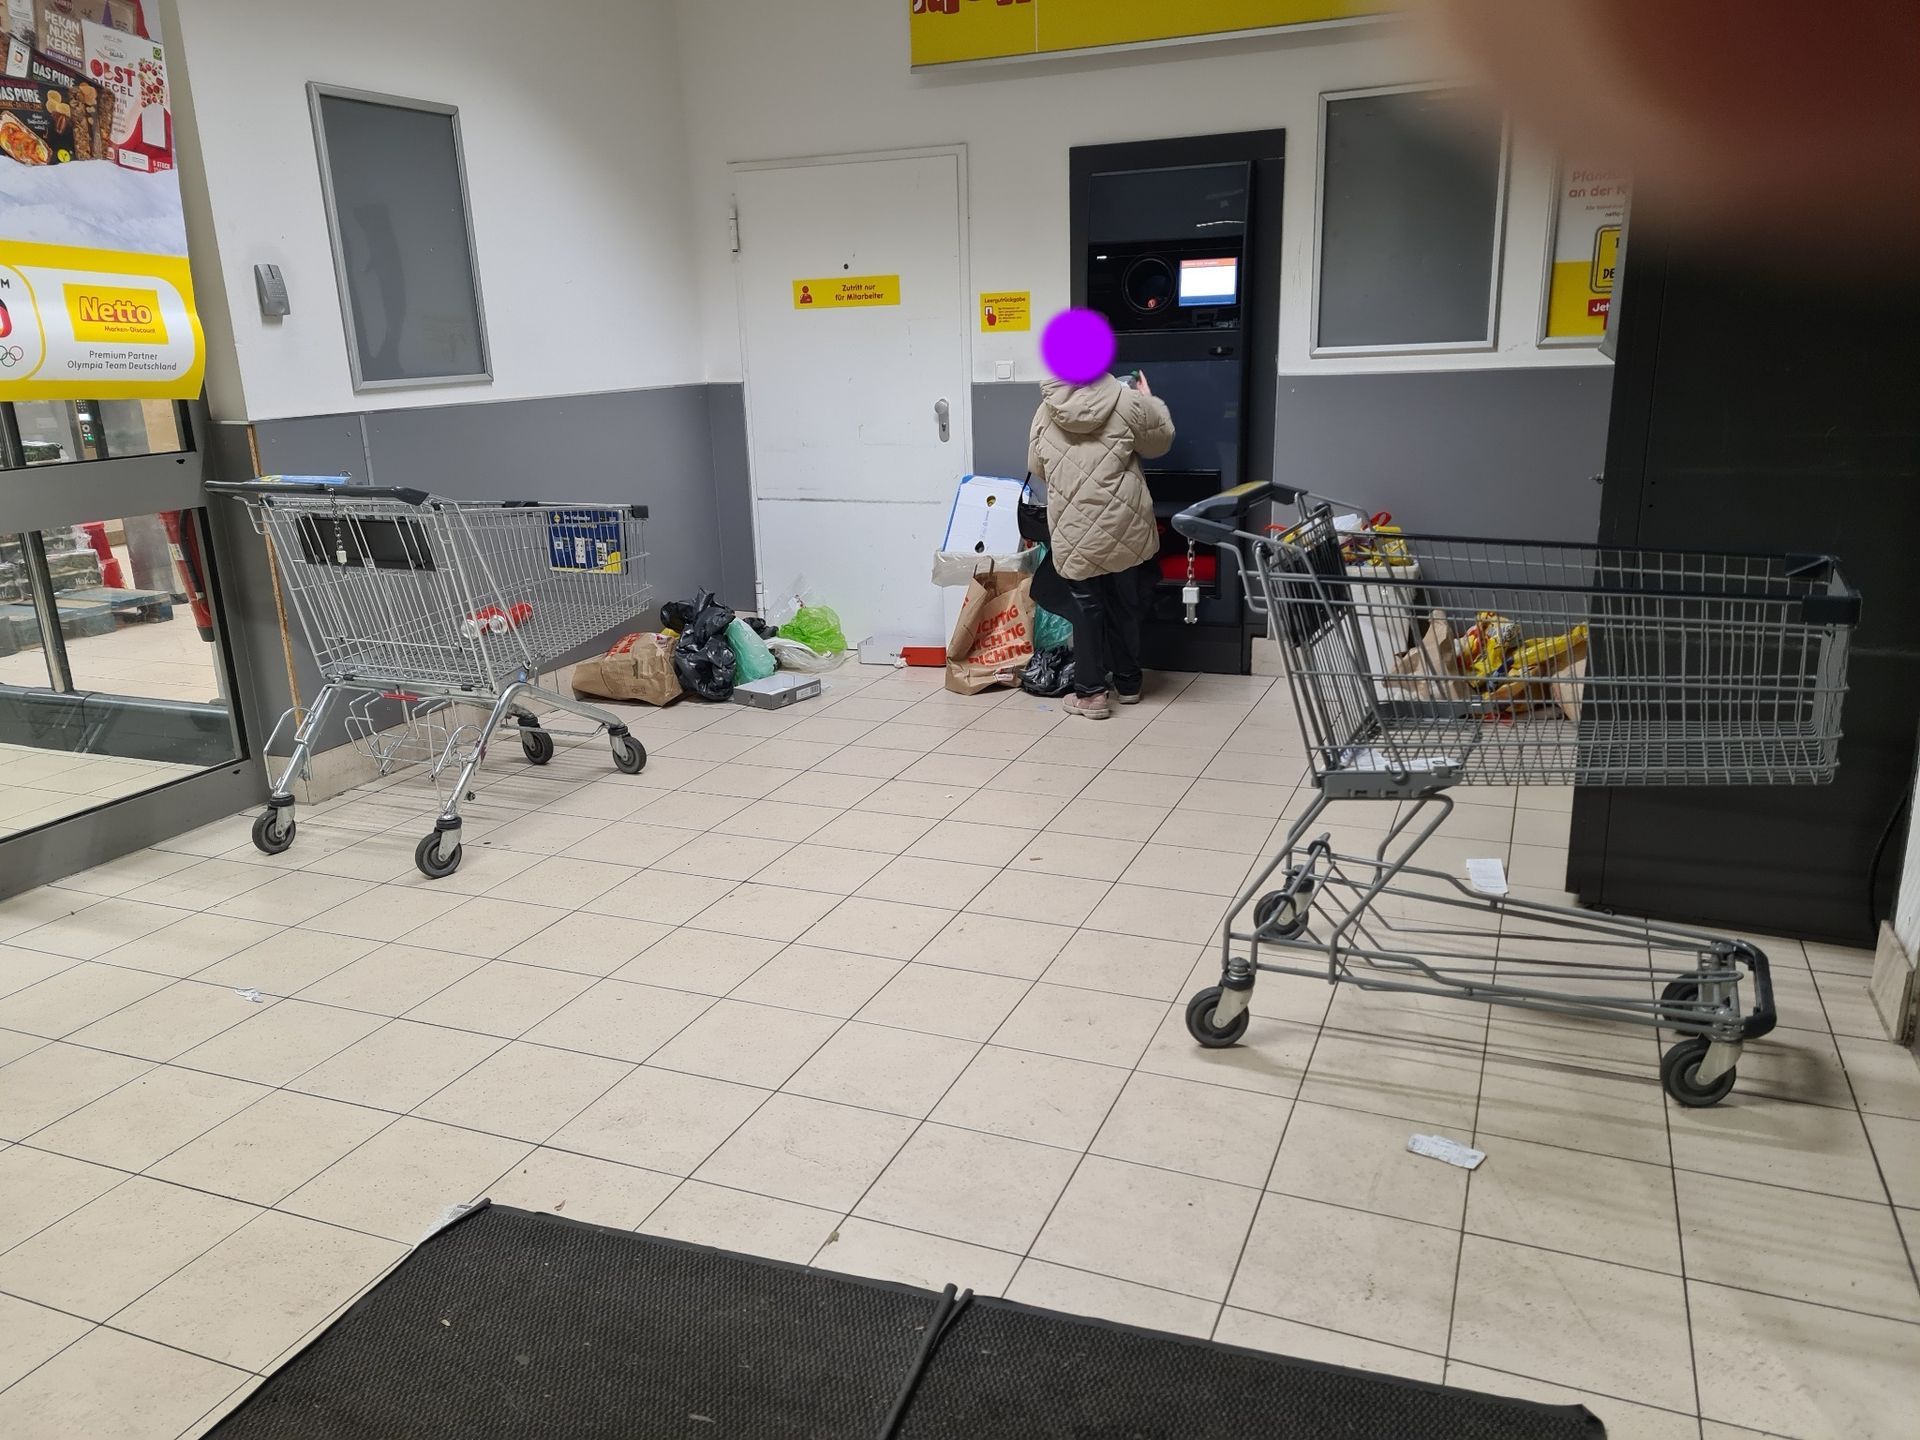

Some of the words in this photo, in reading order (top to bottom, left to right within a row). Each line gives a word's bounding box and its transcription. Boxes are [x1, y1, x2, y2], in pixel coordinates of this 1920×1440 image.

[44, 9, 80, 35] PEKAN
[49, 23, 77, 44] NUSS
[47, 35, 83, 59] KERNE
[33, 62, 51, 80] DAS
[52, 69, 76, 88] PURE
[90, 58, 136, 87] OBST
[0, 87, 14, 101] AS
[14, 88, 41, 103] PURE
[1568, 188, 1586, 198] an
[1602, 267, 1615, 280] DE
[0, 278, 10, 289] M
[842, 284, 863, 292] Zutritt
[835, 293, 845, 301] für
[846, 292, 884, 301] Mitarbeiter
[79, 295, 152, 325] Netto
[1592, 302, 1611, 313] Jet
[105, 325, 156, 334] Marken-Discount
[89, 350, 127, 360] Premium
[128, 352, 158, 360] Partner
[67, 360, 103, 371] Olympia
[105, 361, 127, 369] Team
[128, 362, 177, 371] Deutschland
[976, 604, 1019, 634] ICHTIG
